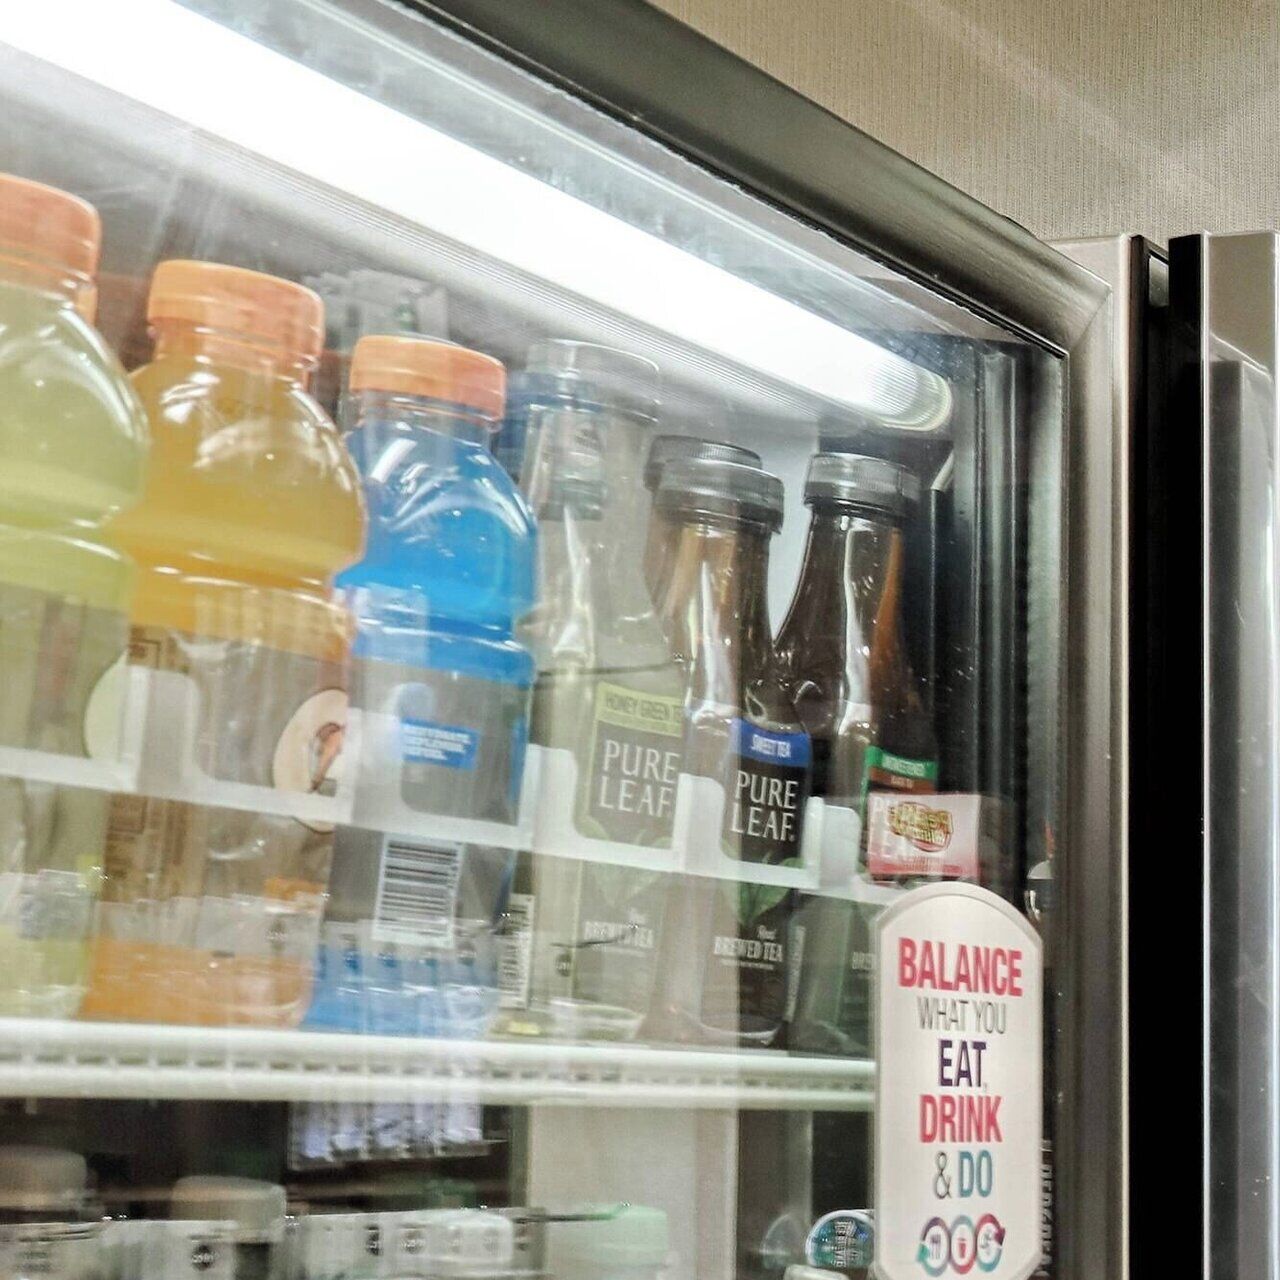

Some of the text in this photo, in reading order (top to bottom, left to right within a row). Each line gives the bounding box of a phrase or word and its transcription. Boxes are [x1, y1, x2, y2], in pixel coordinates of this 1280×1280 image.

[603, 739, 681, 784] PURE
[735, 770, 799, 810] PURE
[715, 936, 784, 962] BREWED TEA
[898, 937, 1024, 997] BALANCE
[917, 996, 1007, 1034] WHAT YOU
[919, 1094, 1004, 1144] DRINK
[934, 1150, 993, 1200] & DO
